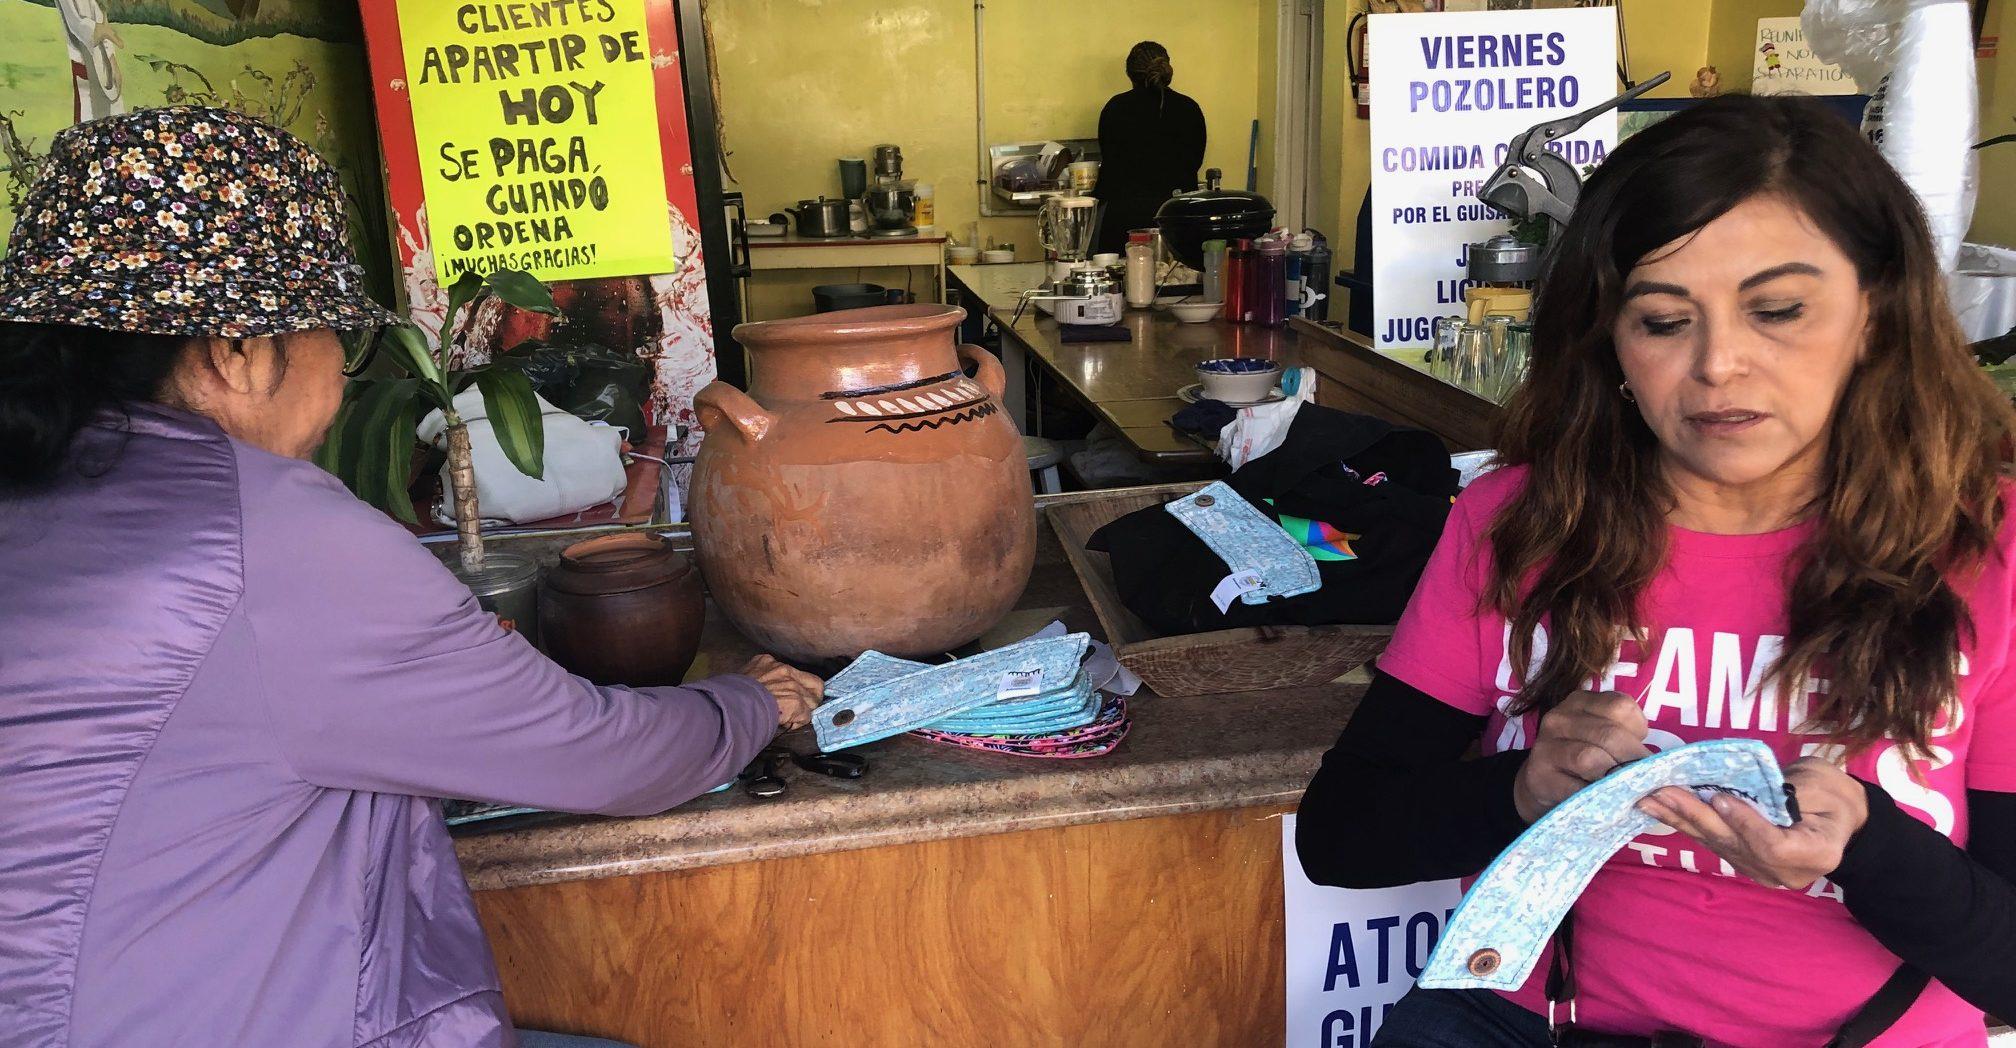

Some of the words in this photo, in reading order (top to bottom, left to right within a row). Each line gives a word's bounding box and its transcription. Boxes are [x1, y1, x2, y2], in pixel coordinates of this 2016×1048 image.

[457, 0, 615, 34] CLIENTES
[419, 33, 587, 85] APARTIR
[600, 31, 645, 63] DE
[1420, 32, 1566, 69] VIERNES
[499, 80, 606, 126] HOY
[1409, 75, 1580, 112] POZOLERO
[440, 142, 480, 182] SE
[1382, 145, 1485, 173] COMIDA
[1494, 139, 1606, 169] CRIDA
[453, 216, 574, 251] ORDENA
[1393, 207, 1426, 224] POR
[1432, 206, 1451, 222] EL
